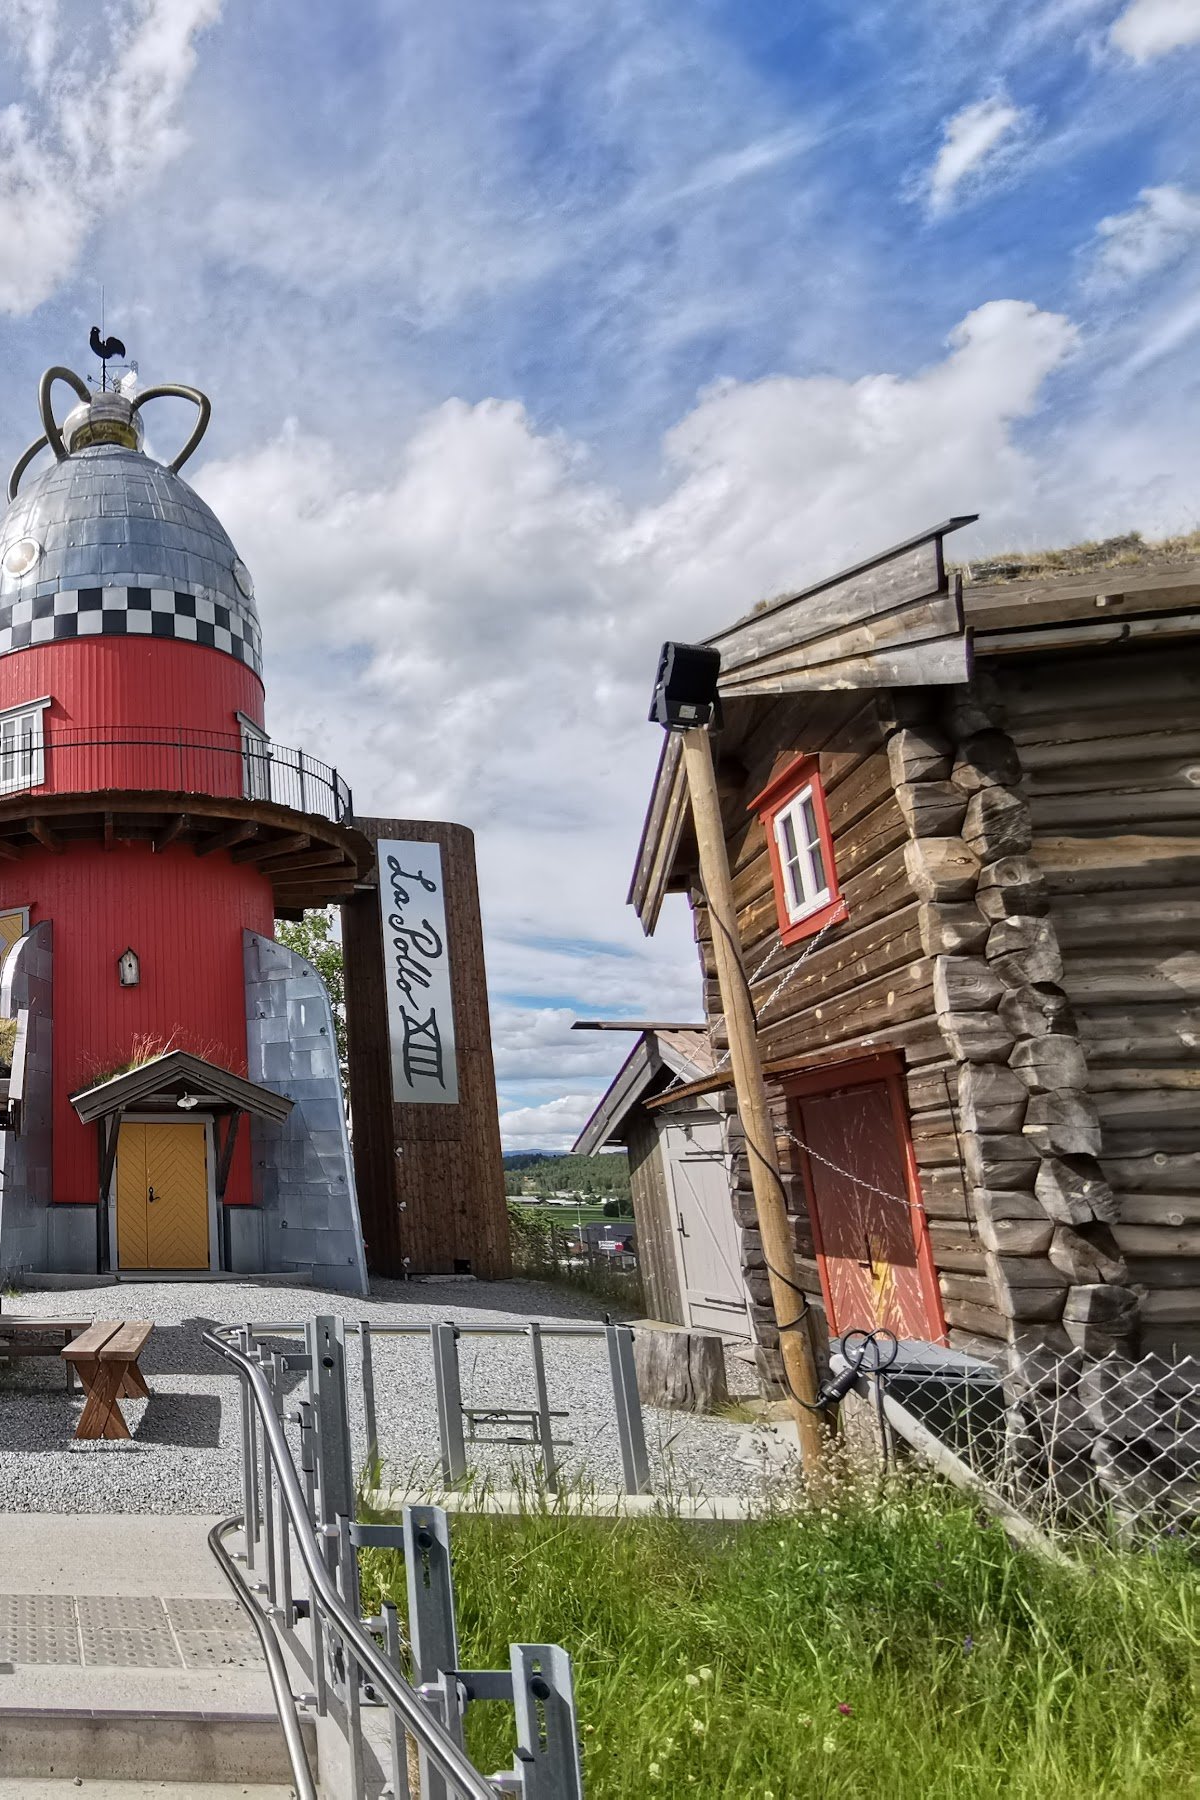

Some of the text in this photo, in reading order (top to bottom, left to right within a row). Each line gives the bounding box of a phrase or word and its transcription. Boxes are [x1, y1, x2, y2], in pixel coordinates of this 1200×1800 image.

[387, 855, 446, 1089] La Pollo XIII
